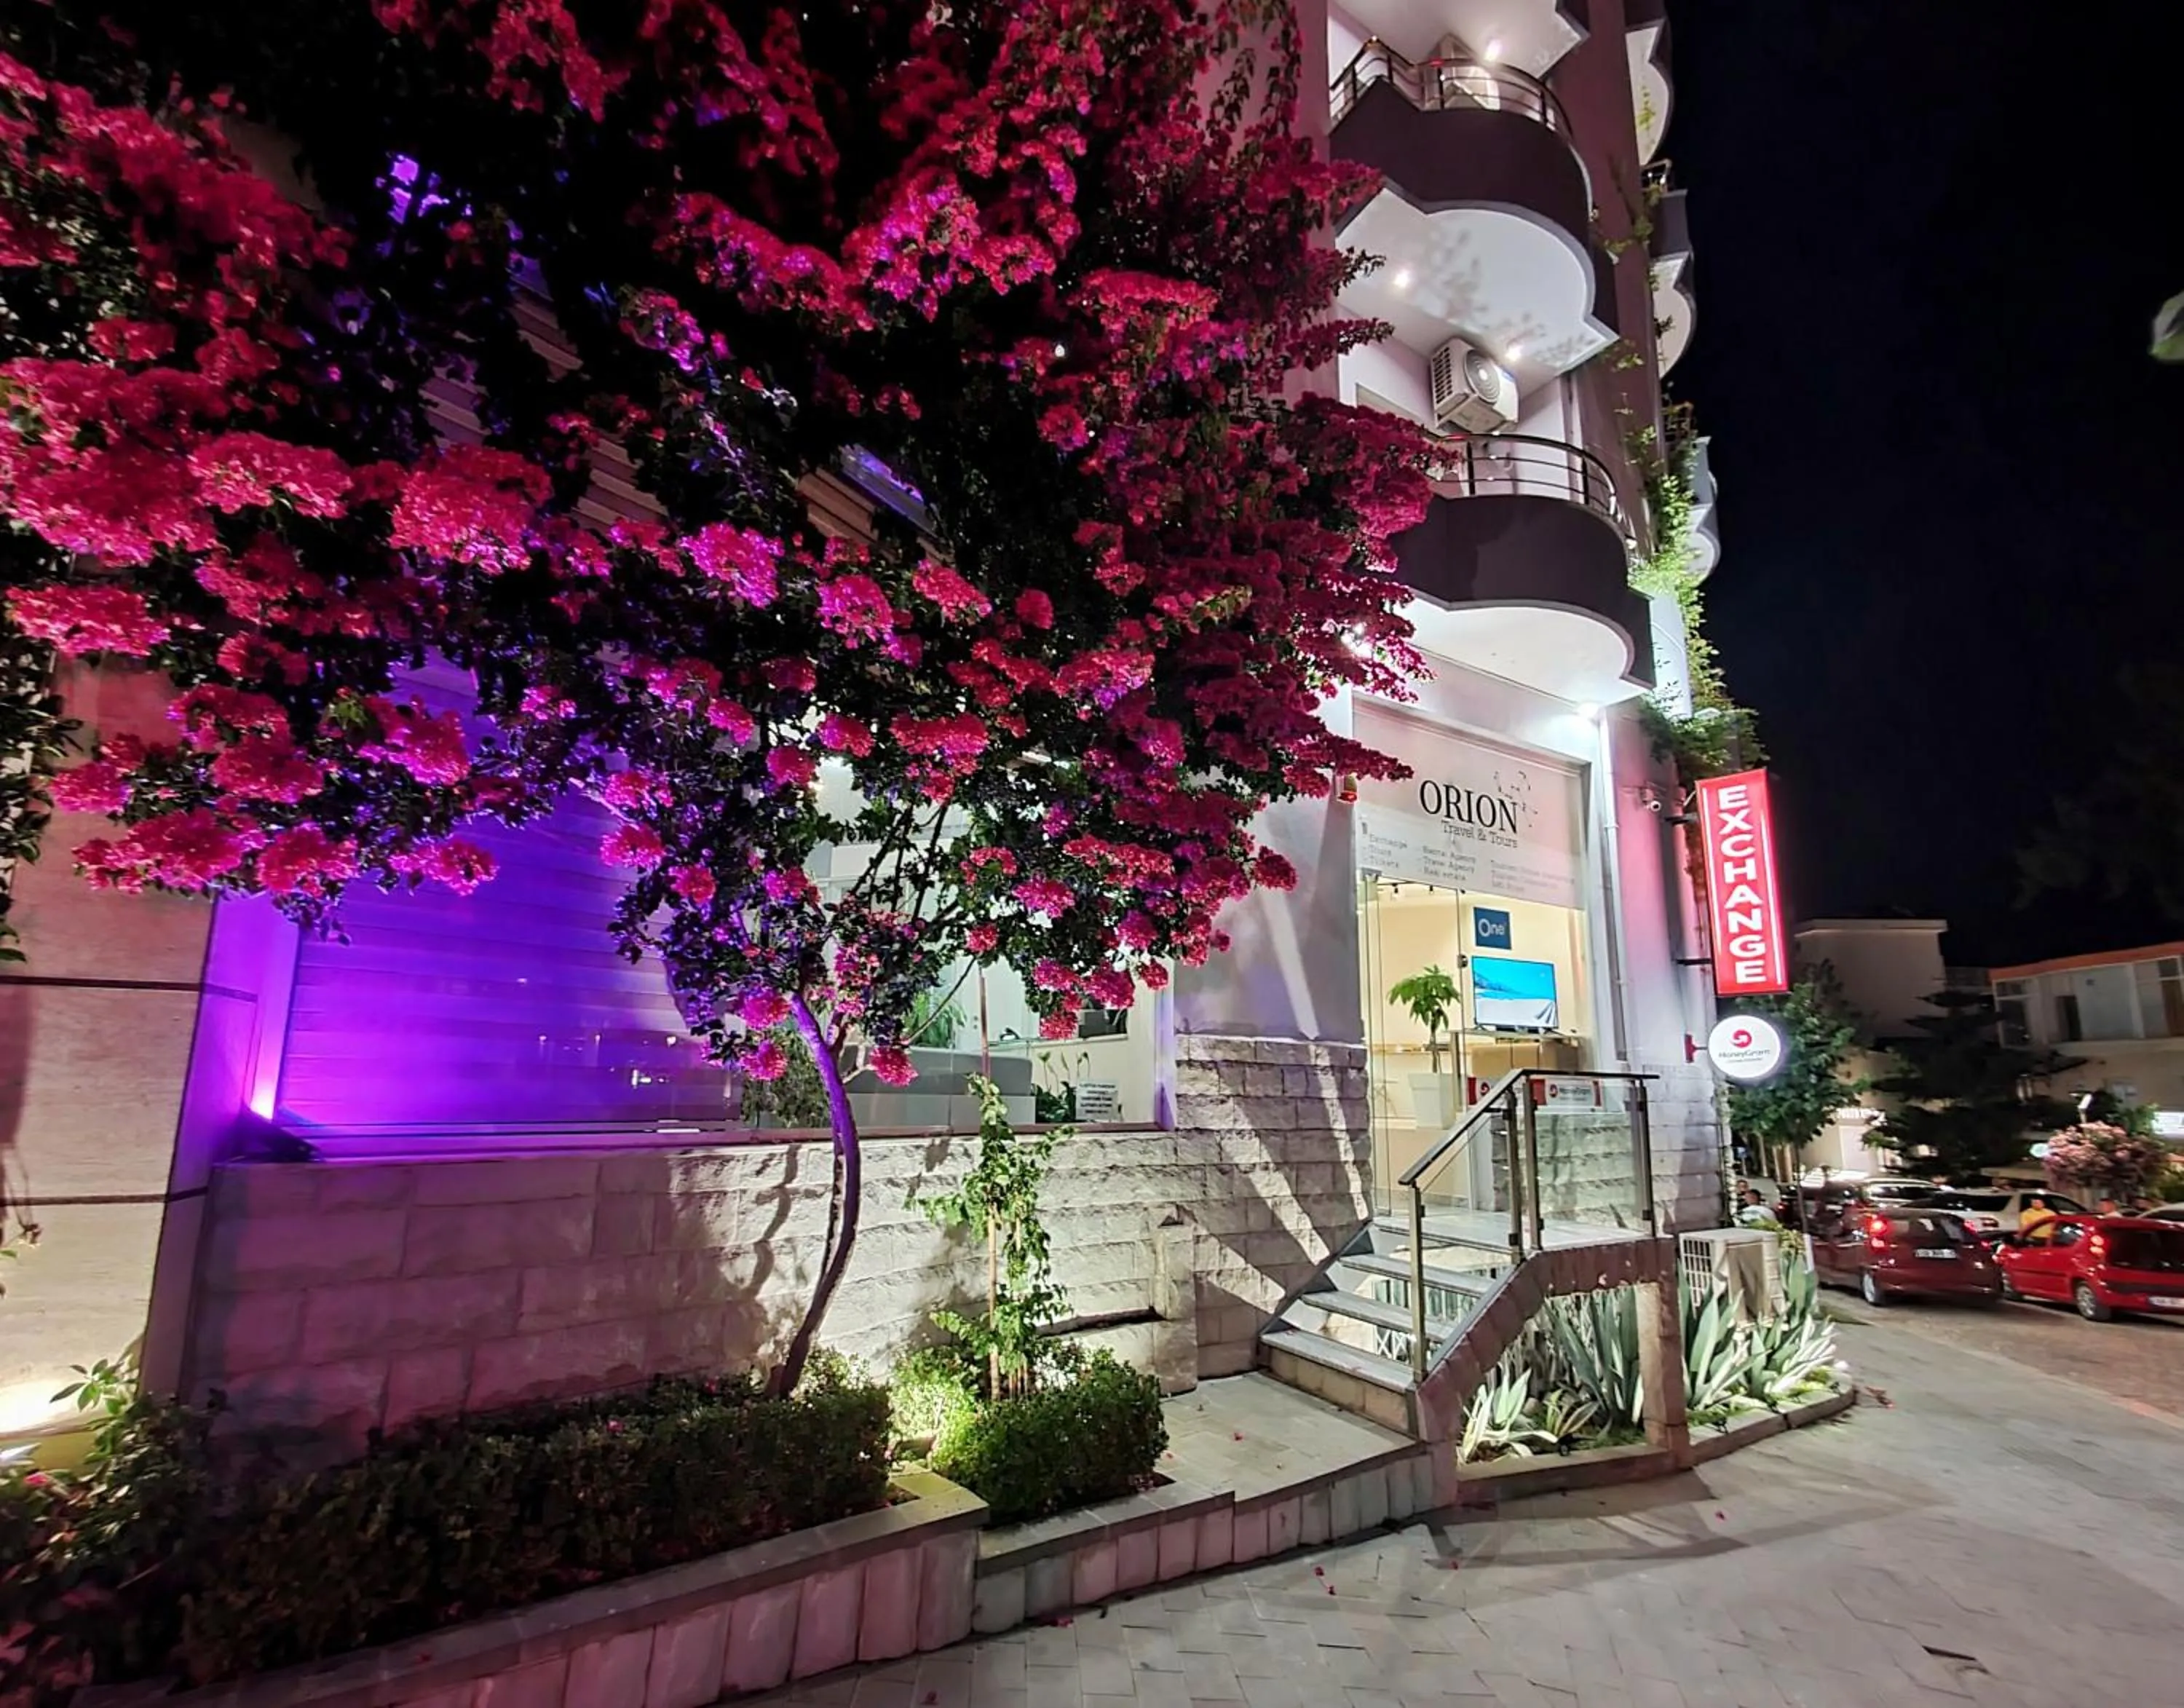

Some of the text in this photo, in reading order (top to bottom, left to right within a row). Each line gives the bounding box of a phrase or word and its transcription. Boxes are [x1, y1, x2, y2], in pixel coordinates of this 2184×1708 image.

[1420, 780, 1518, 834] ORION
[1441, 820, 1518, 848] Travel & Tours
[1717, 784, 1768, 984] EXCHANGE
[1479, 918, 1505, 937] One
